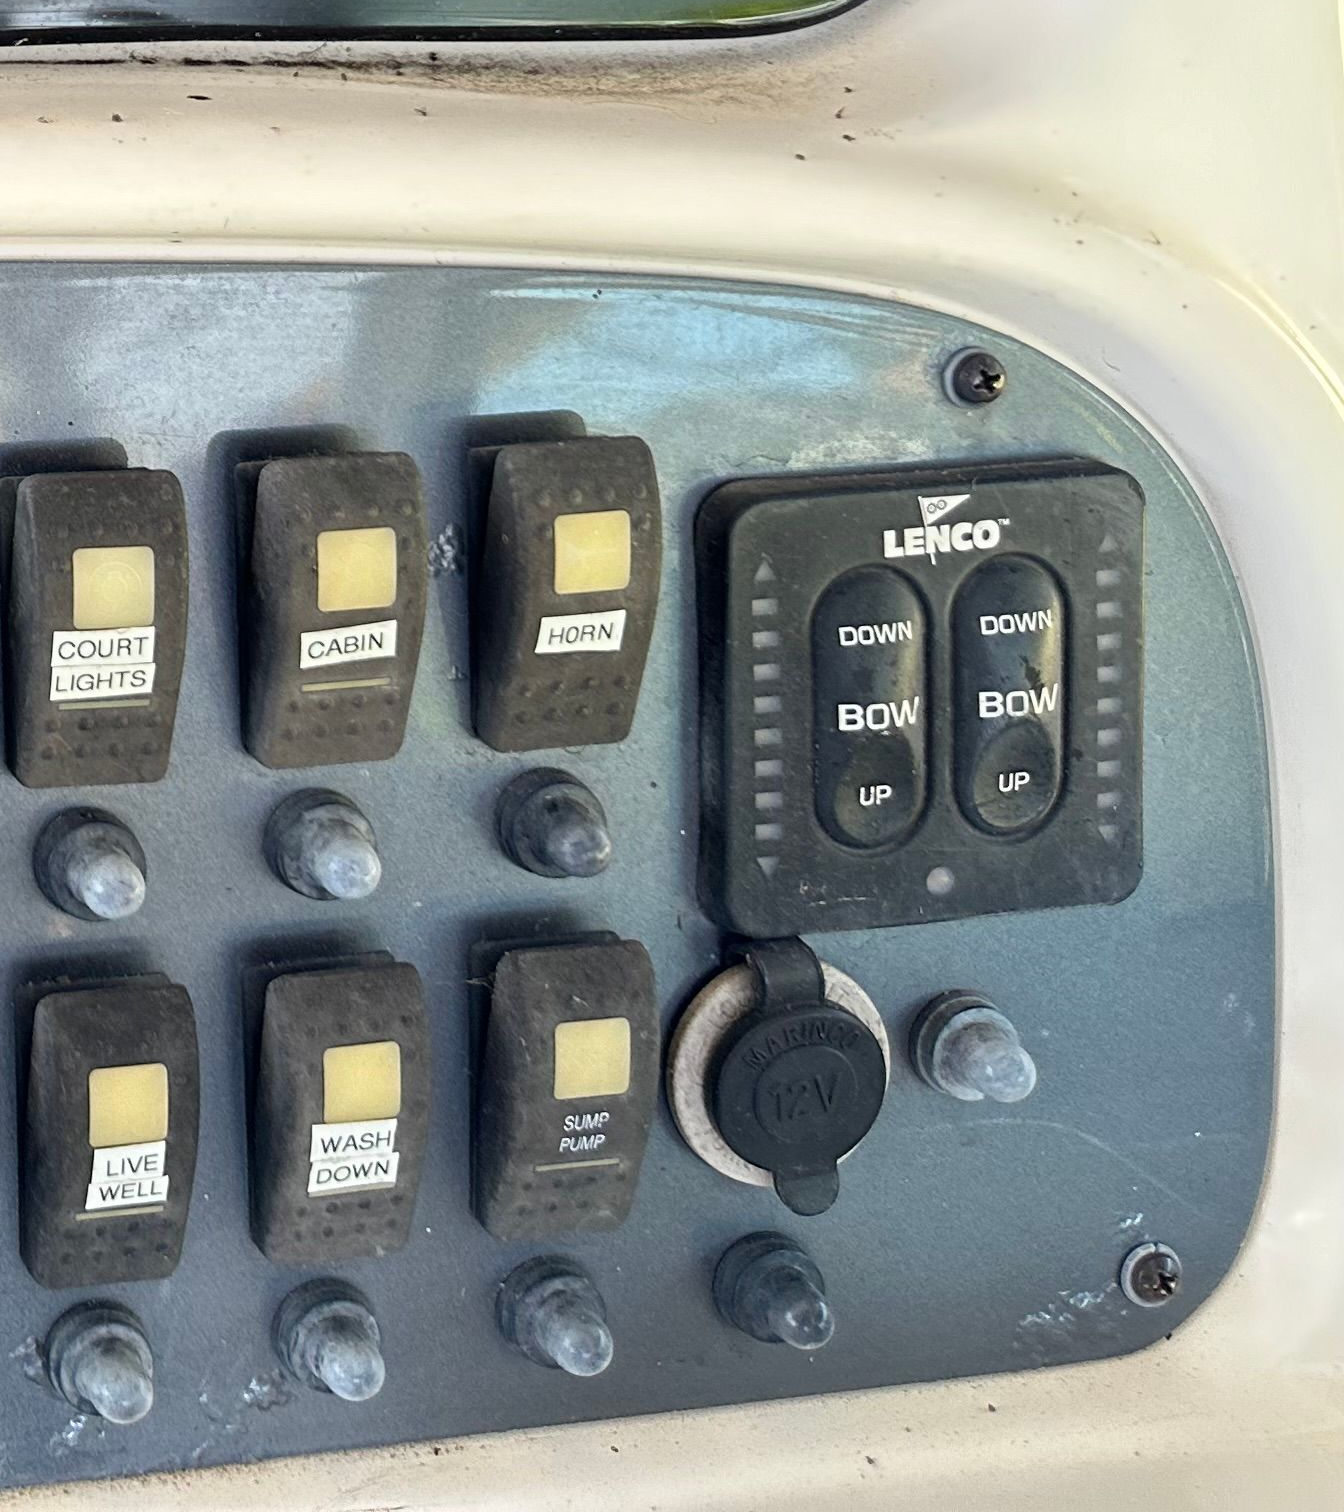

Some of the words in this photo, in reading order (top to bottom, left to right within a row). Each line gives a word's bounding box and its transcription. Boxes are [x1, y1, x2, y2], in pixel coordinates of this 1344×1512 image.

[883, 519, 1000, 559] LENCO
[547, 621, 615, 645] HORN
[838, 620, 913, 646] DOWN
[980, 609, 1053, 635] DOWN
[57, 636, 149, 661] COURT
[307, 631, 385, 661] CABIN
[55, 669, 147, 693] LIGHTS
[978, 683, 1059, 718] BOW
[838, 696, 920, 731] BOW
[998, 771, 1030, 792] UP
[859, 784, 892, 806] UP
[768, 1070, 840, 1121] 12V
[563, 1111, 610, 1132] SUMP
[320, 1130, 393, 1156] WASH
[559, 1134, 606, 1152] PUMP
[107, 1153, 159, 1177] LIVE
[316, 1160, 390, 1186] DOWN
[98, 1180, 163, 1201] WELL
